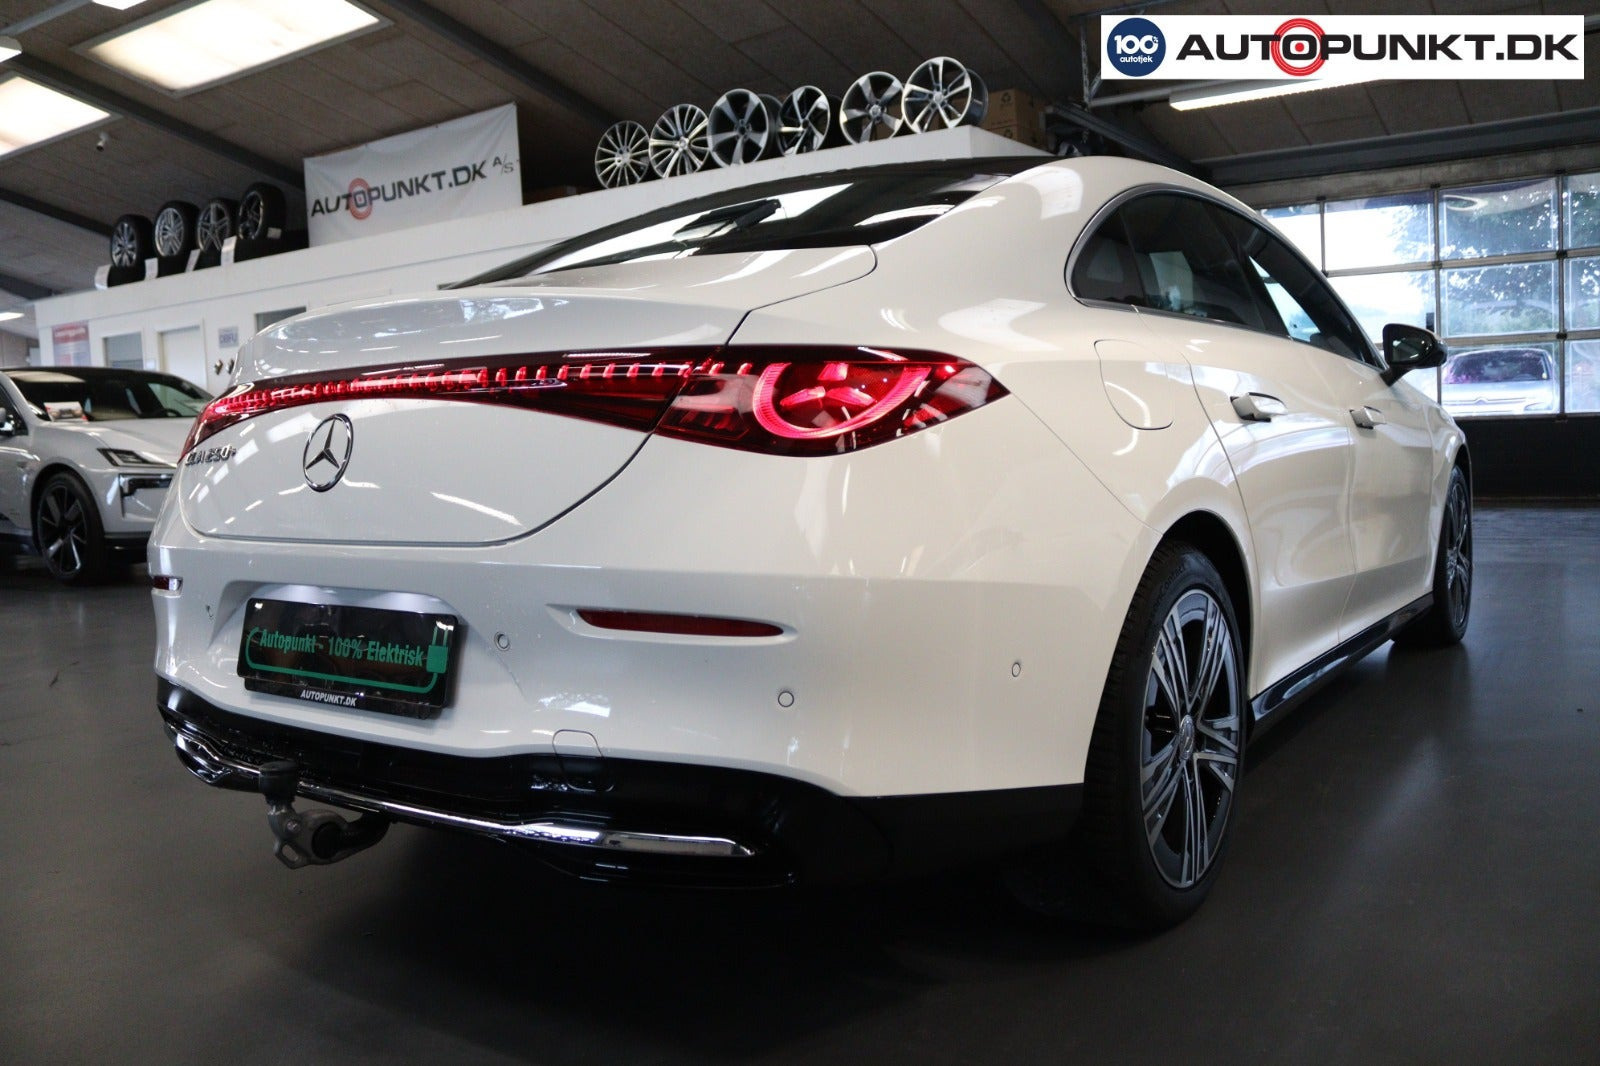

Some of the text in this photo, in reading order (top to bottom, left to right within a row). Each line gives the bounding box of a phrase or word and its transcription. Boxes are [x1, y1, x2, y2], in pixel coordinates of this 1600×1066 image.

[310, 153, 514, 217] AUTOPUNKT.DK A/S
[260, 629, 316, 654] Autopunkt
[328, 637, 363, 660] 100%
[366, 641, 424, 667] Elektrisk
[301, 690, 357, 707] AUTOPUNKT.DK
